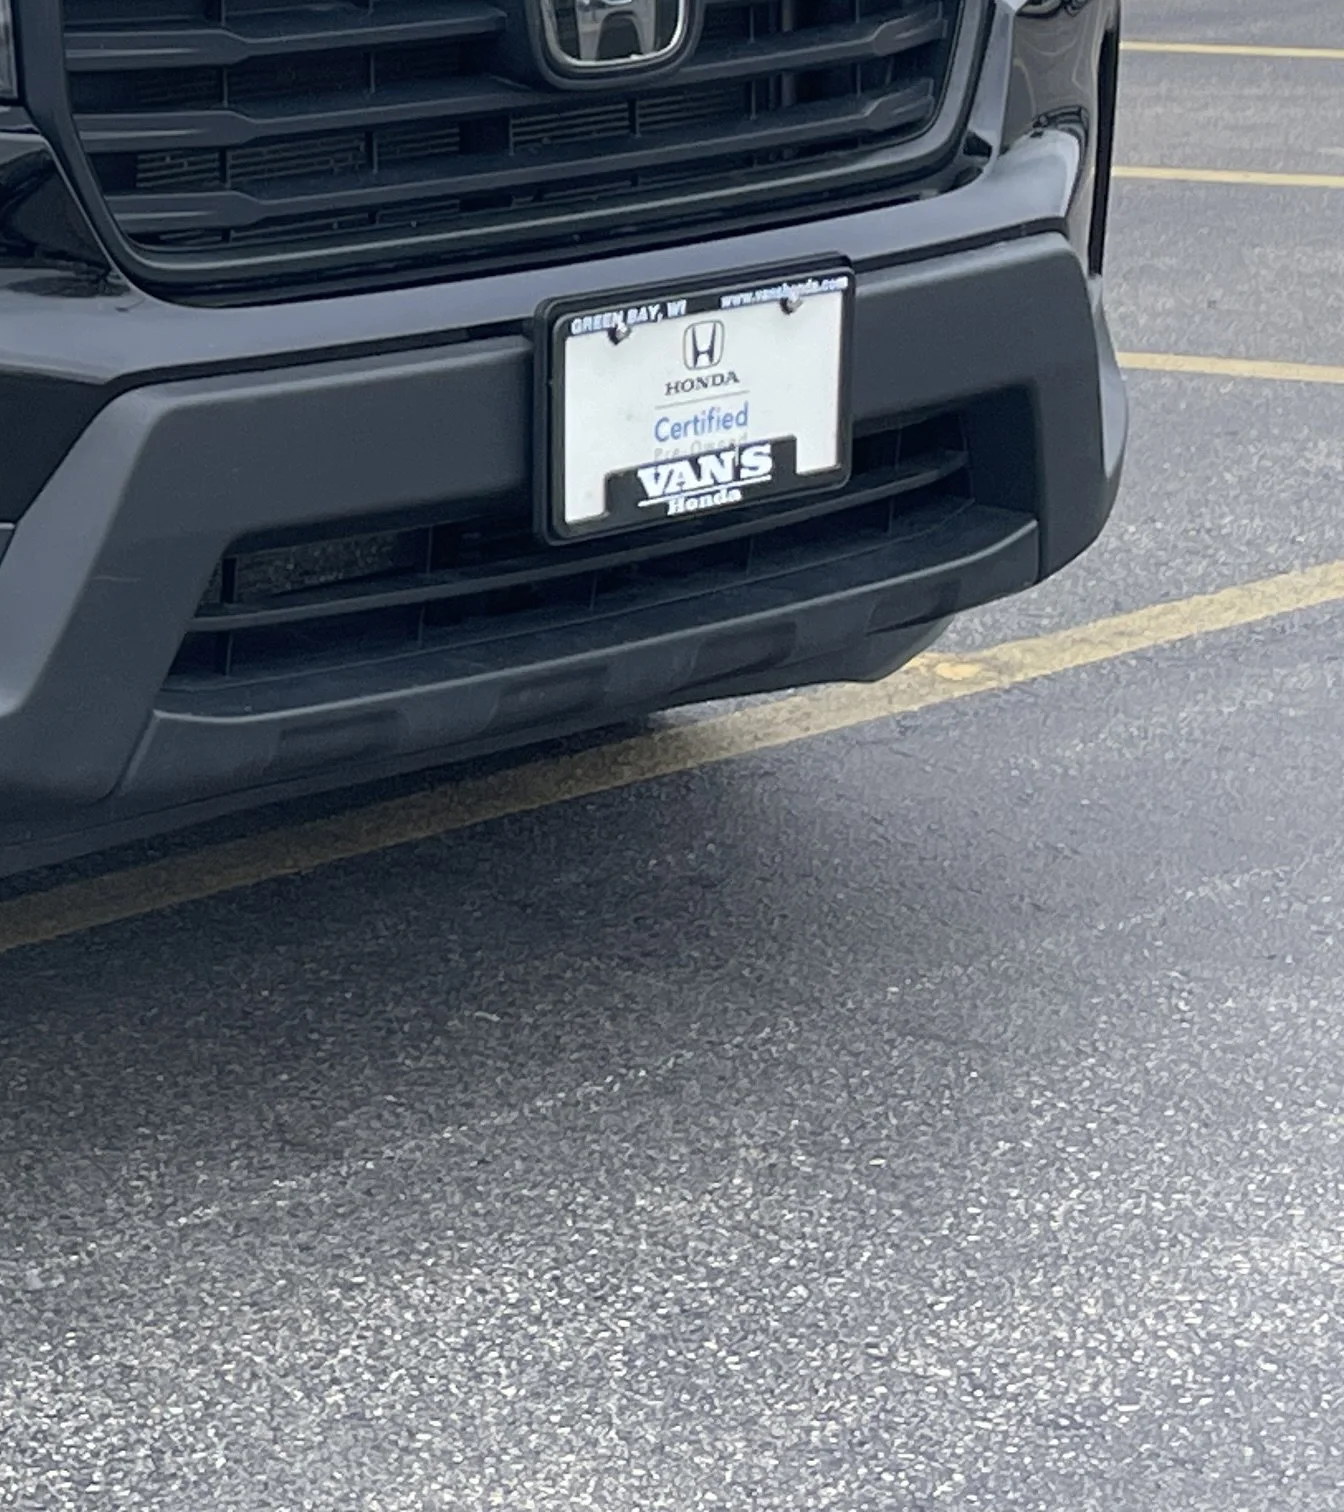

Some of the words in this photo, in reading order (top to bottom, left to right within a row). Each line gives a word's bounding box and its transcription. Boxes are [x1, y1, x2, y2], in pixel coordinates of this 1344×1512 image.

[571, 310, 624, 335] GREEN
[667, 299, 687, 318] WI
[664, 370, 741, 396] HONDA
[654, 399, 750, 443] Certified
[666, 487, 743, 516] Honda
